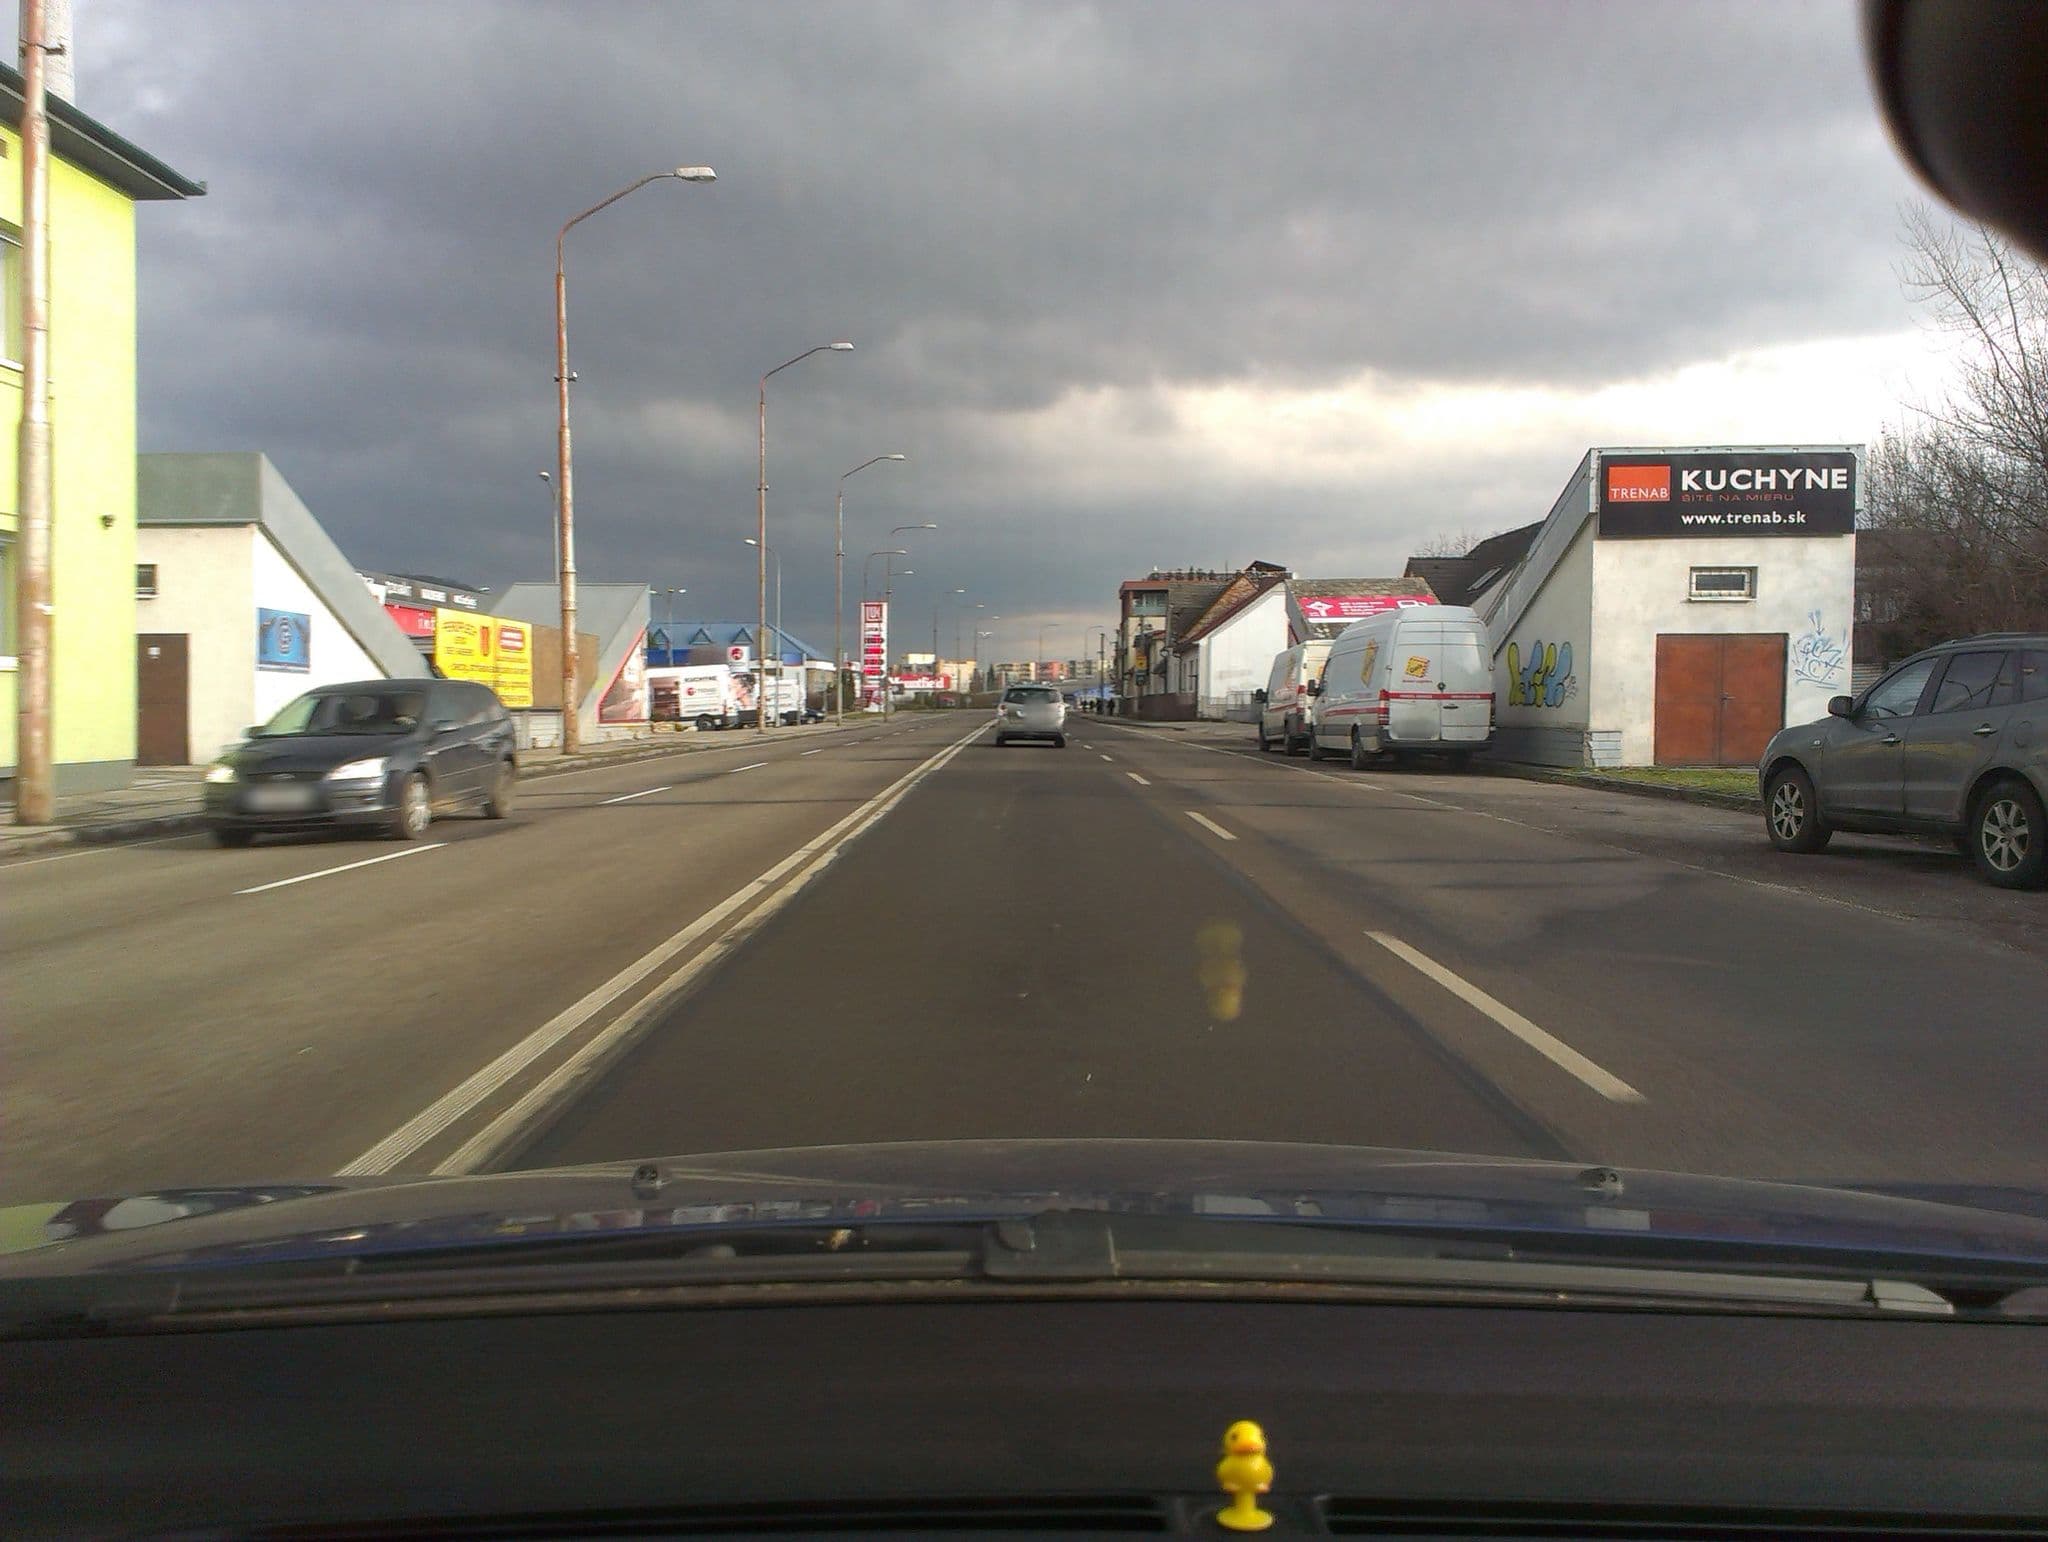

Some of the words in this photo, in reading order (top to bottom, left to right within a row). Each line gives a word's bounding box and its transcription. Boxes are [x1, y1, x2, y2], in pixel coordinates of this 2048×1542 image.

[1681, 468, 1848, 491] KUCHYNE
[1610, 488, 1670, 500] TRENAB
[1719, 493, 1740, 502] NA
[1681, 510, 1807, 525] www.trenab.sk
